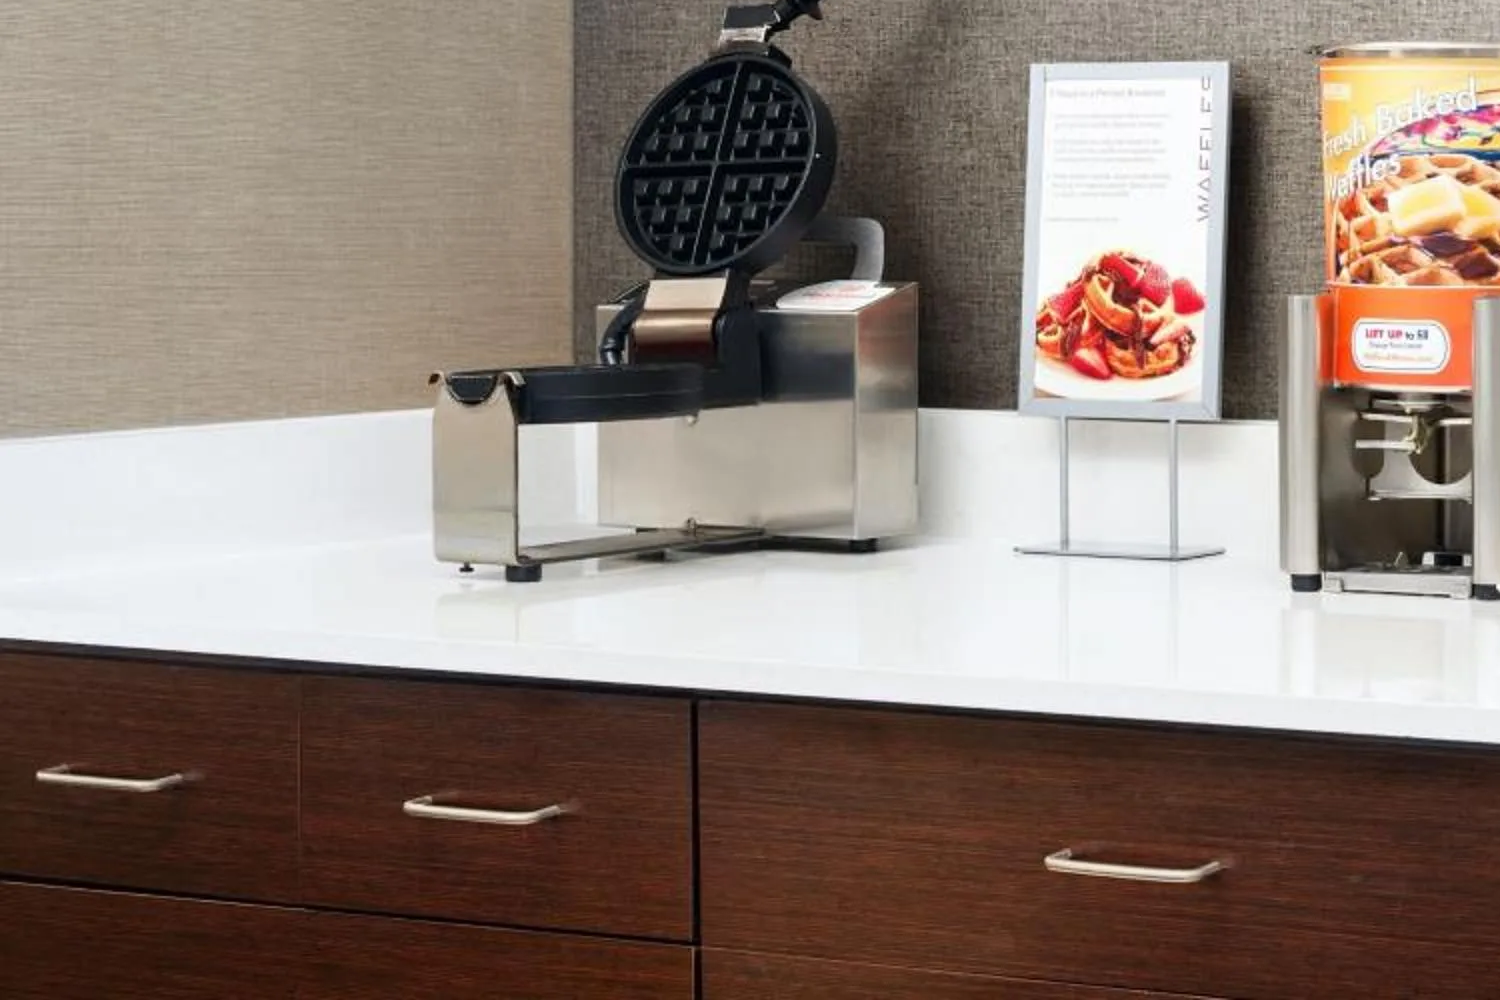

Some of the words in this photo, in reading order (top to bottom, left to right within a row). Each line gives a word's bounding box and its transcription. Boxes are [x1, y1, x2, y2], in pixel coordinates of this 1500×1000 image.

[1376, 76, 1478, 135] Baked
[1365, 327, 1384, 339] LIFT
[1387, 328, 1403, 340] UP
